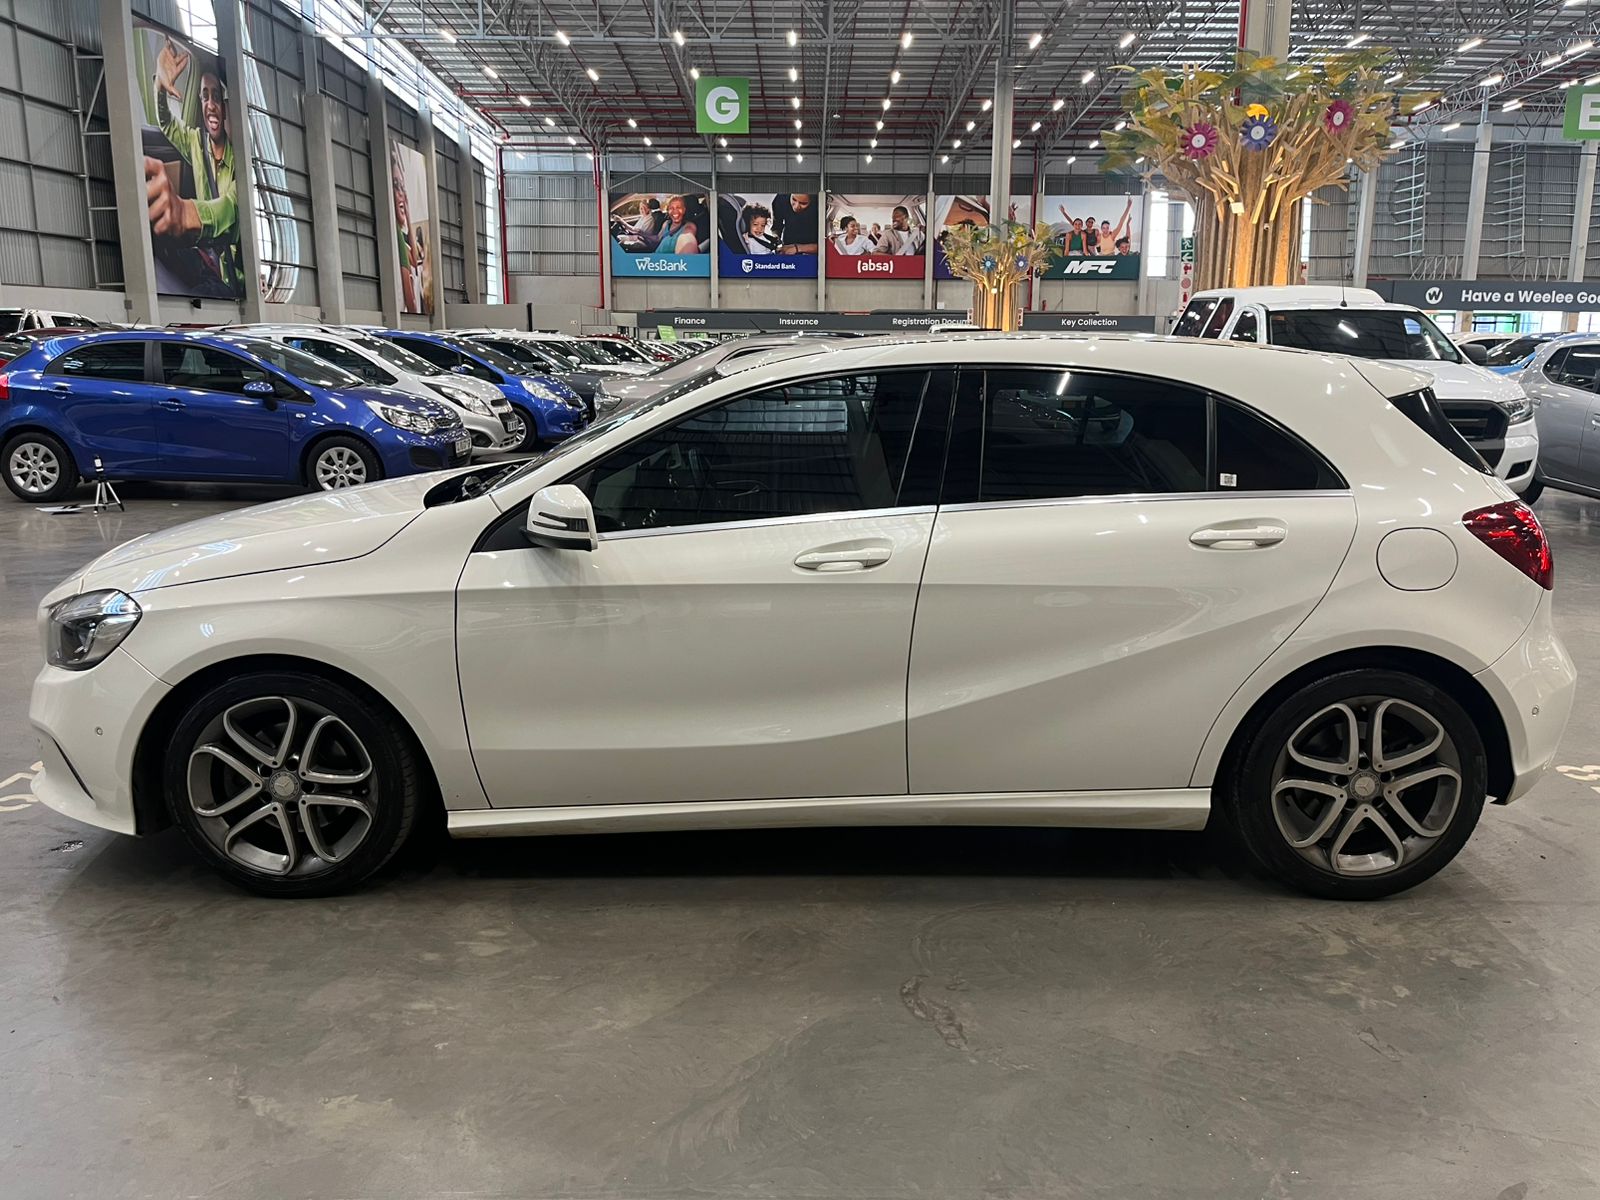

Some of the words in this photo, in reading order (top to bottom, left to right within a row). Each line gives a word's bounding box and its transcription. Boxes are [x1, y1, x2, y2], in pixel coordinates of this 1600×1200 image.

[705, 86, 740, 124] G
[1578, 93, 1600, 130] E
[635, 257, 688, 272] WesBank
[754, 262, 780, 271] Standard
[781, 262, 796, 271] Bank
[857, 259, 894, 274] (absa)
[1063, 260, 1117, 274] MFC
[1461, 289, 1501, 304] Have
[1504, 292, 1515, 304] a
[1518, 290, 1574, 304] Weelee
[674, 317, 706, 325] Finance
[779, 317, 819, 326] Insurance
[892, 318, 939, 327] Registration
[1061, 318, 1076, 327] Key
[1077, 318, 1118, 327] Collection
